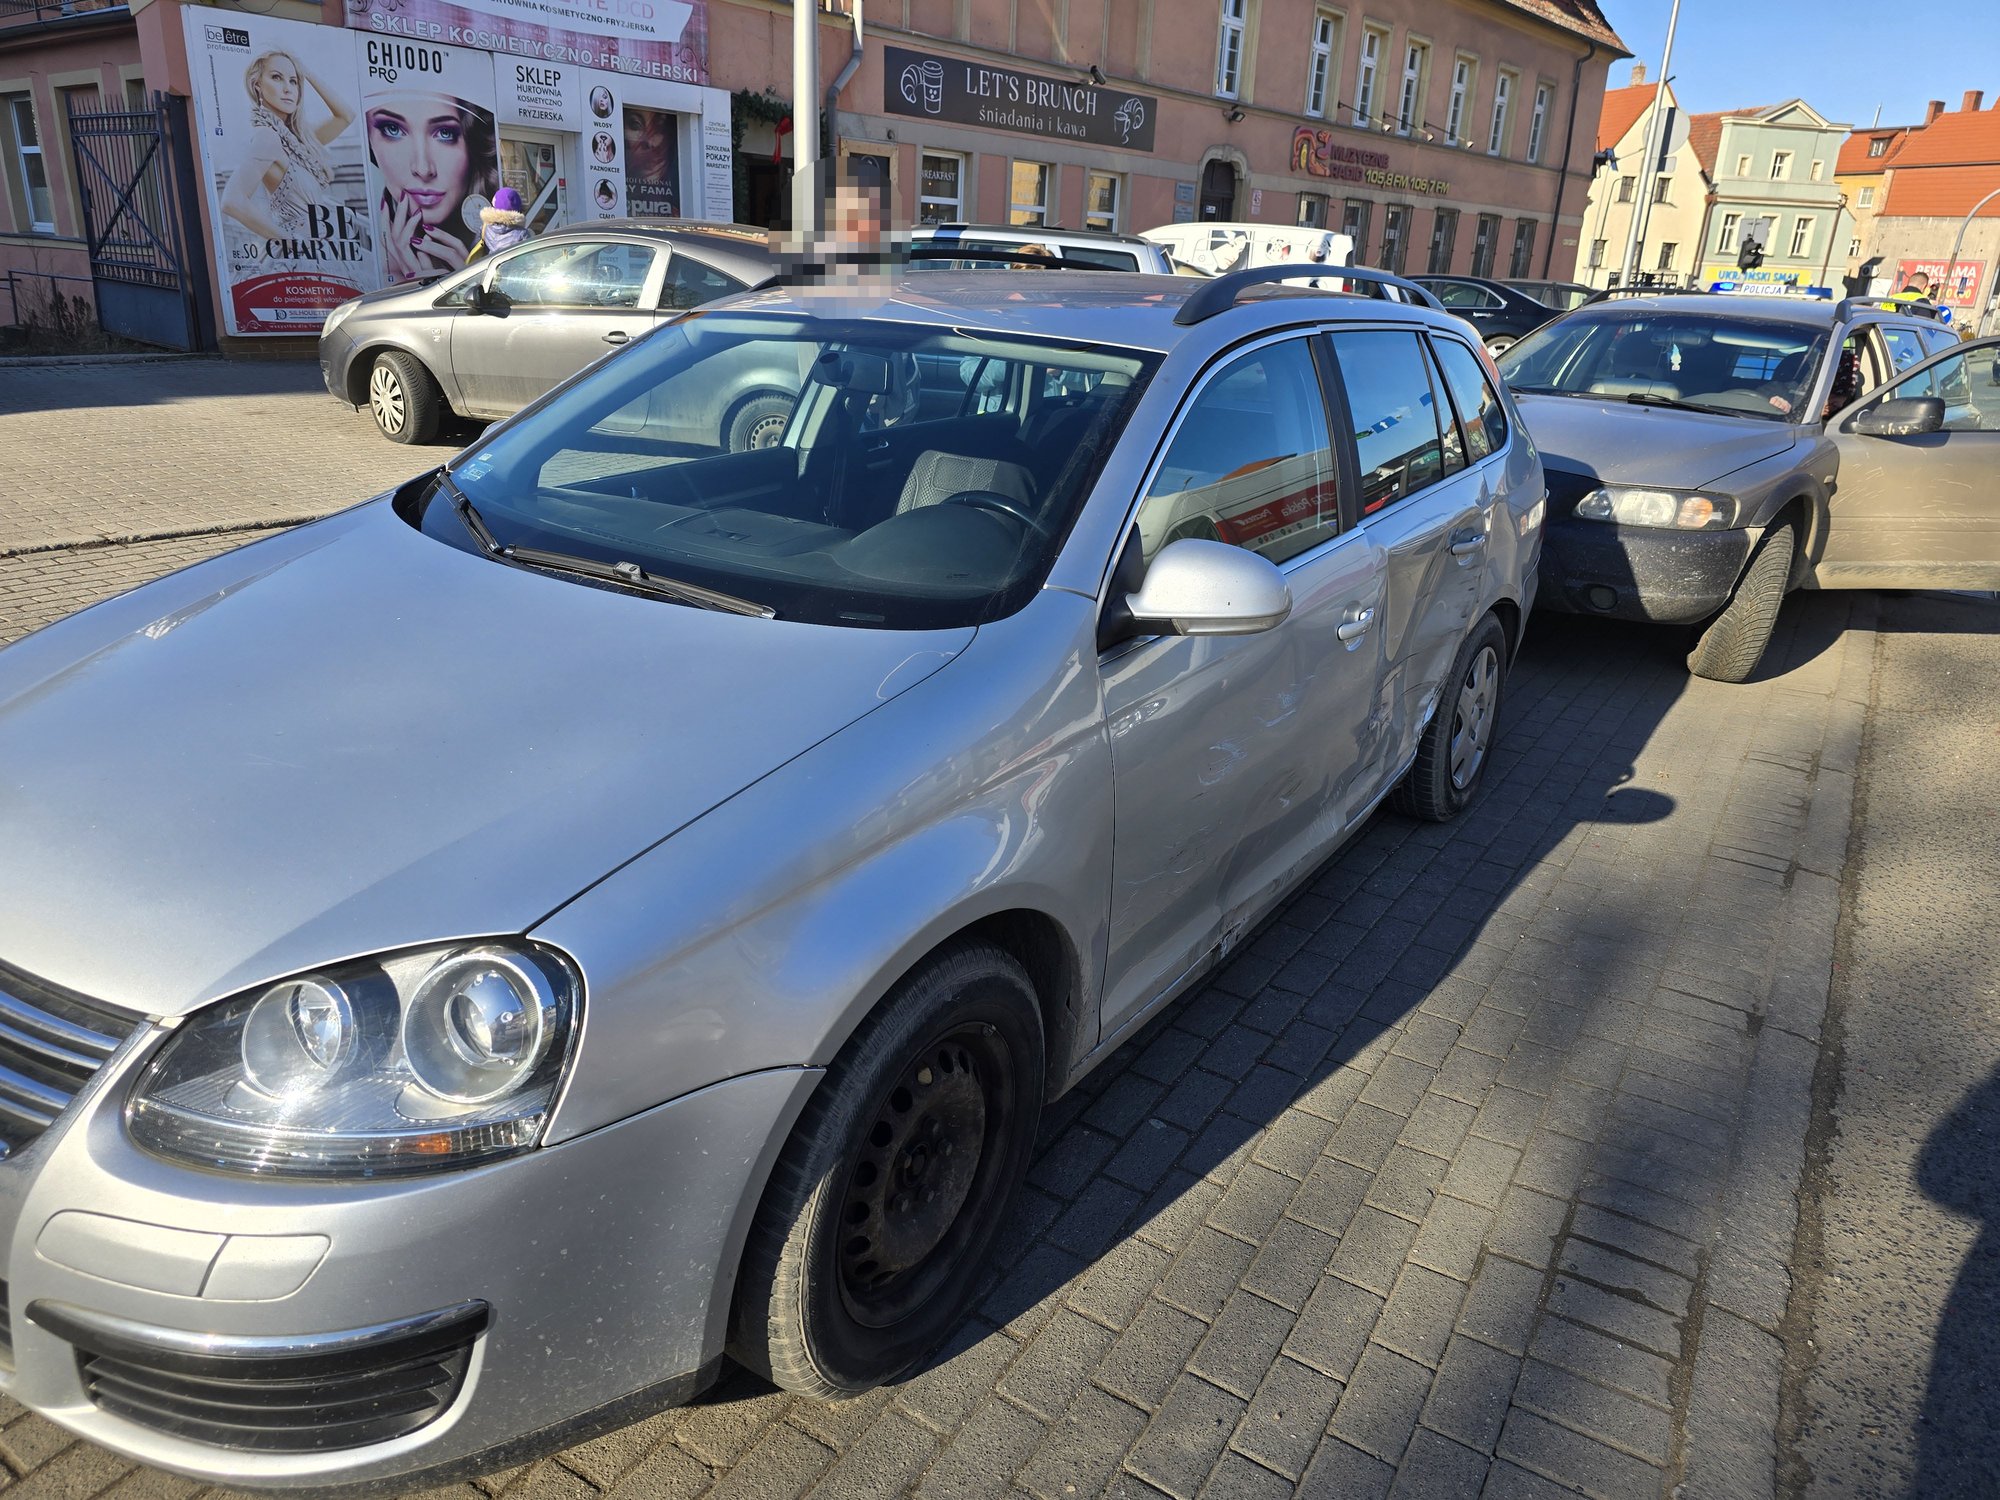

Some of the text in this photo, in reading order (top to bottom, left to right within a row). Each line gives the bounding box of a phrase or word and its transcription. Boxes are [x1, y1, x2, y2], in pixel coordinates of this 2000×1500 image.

[539, 4, 656, 34] KOSMETYCZNO-FRYZJERSKA
[206, 27, 248, 45] be être
[206, 43, 252, 55] professional
[370, 12, 698, 82] SKLEP KOSMETYCZNO-FRYZJERSKI
[367, 40, 443, 74] CHIODO
[369, 66, 398, 83] PRO
[516, 65, 561, 87] SKLEP
[516, 84, 562, 98] HURTOWNIA
[966, 67, 1097, 116] LET'S BRUNCH
[517, 95, 563, 107] KOSMETYCZNO
[518, 108, 564, 122] FRYZJERSKA
[979, 104, 1086, 137] śniadania i kawa
[705, 153, 730, 162] POKAZY
[1330, 144, 1389, 169] MUZYCZNE
[590, 165, 620, 173] PAZNOKCIE
[1365, 169, 1450, 194] 105,8 FM 106,7 FM
[640, 185, 673, 196] FAMA
[307, 204, 361, 240] BE
[265, 238, 363, 262] CHARME
[285, 286, 335, 296] KOSMETYKI
[1743, 285, 1783, 295] POLICJA
[272, 295, 283, 303] do
